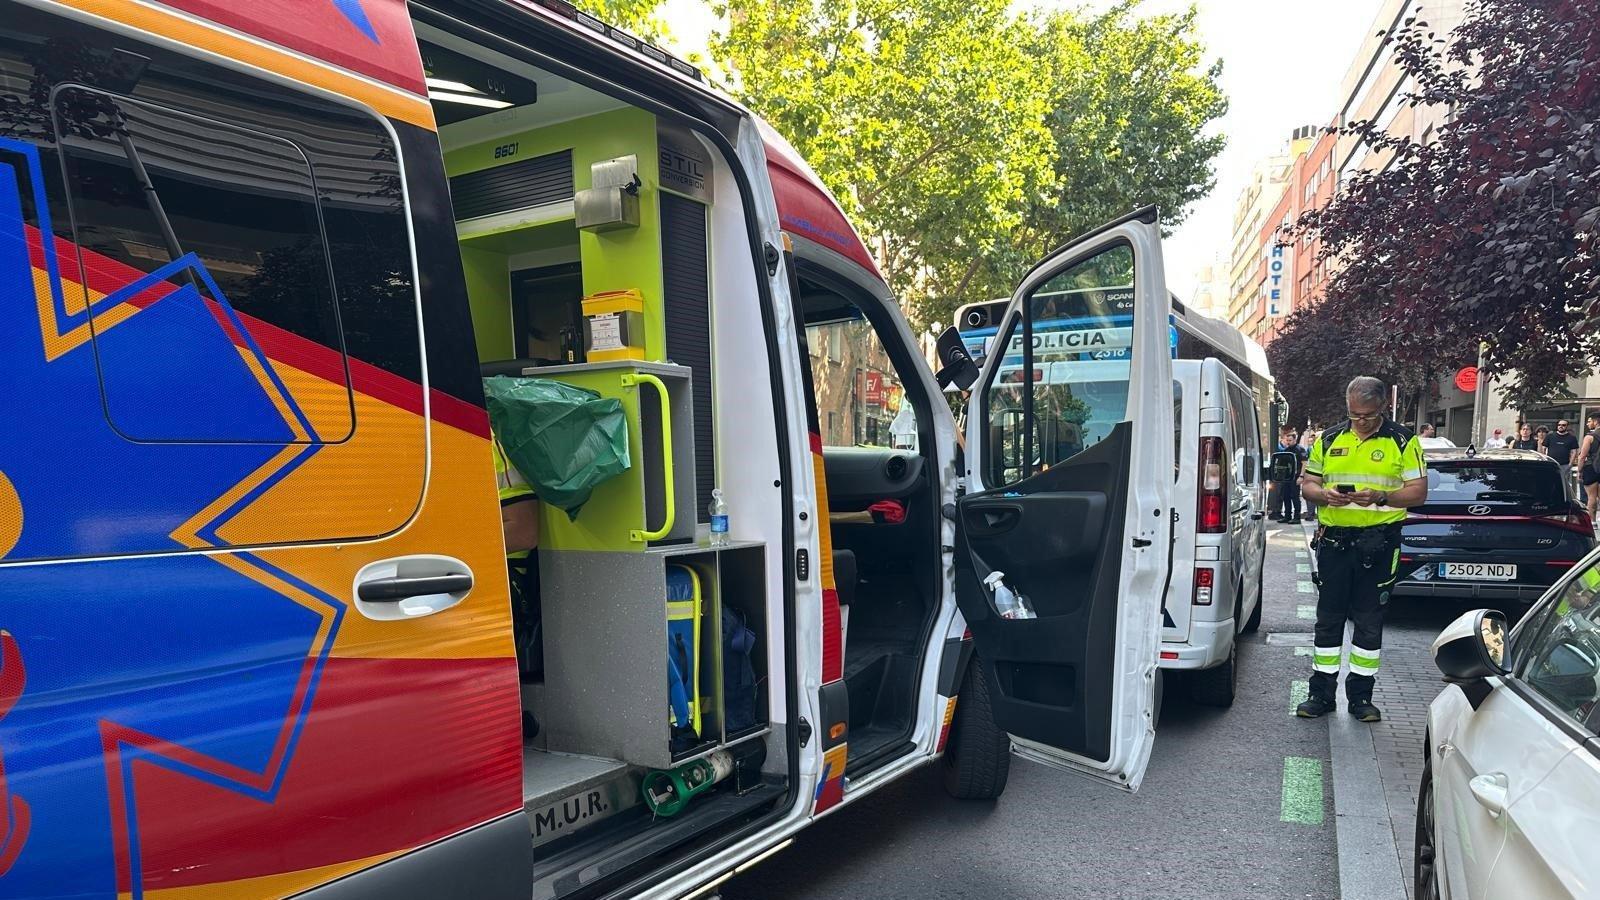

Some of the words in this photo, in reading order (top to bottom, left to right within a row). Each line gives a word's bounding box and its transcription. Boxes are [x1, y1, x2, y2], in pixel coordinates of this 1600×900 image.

[660, 151, 704, 178] STIL
[660, 171, 705, 190] CONVERSION
[1270, 245, 1283, 315] HOTEL
[1107, 292, 1133, 301] SCANI
[1012, 332, 1106, 350] POLICIA
[1448, 564, 1483, 576] 2502
[1487, 565, 1514, 577] NDJ
